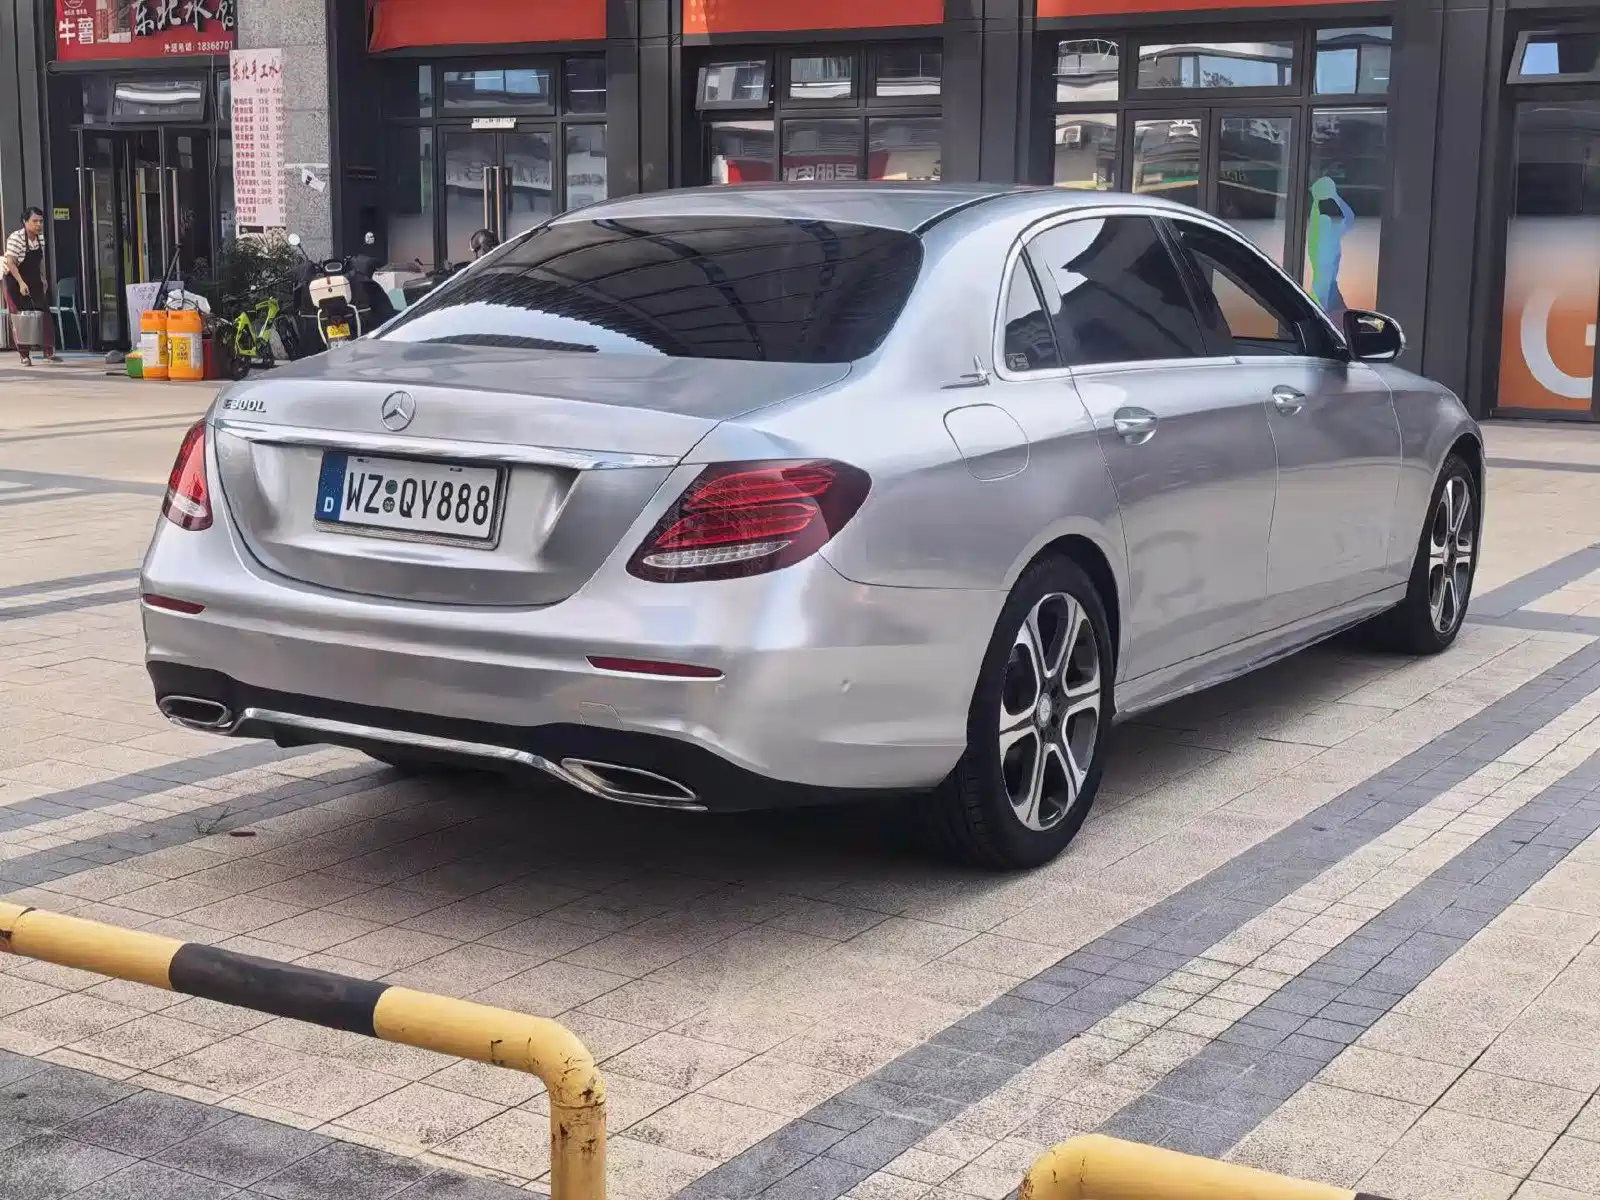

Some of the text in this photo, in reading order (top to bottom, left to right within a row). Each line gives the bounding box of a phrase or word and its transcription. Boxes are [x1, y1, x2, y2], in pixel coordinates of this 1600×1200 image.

[59, 17, 94, 45] 牛薯
[223, 399, 267, 413] E300L
[323, 496, 334, 513] D
[345, 472, 490, 526] WZ QY888
